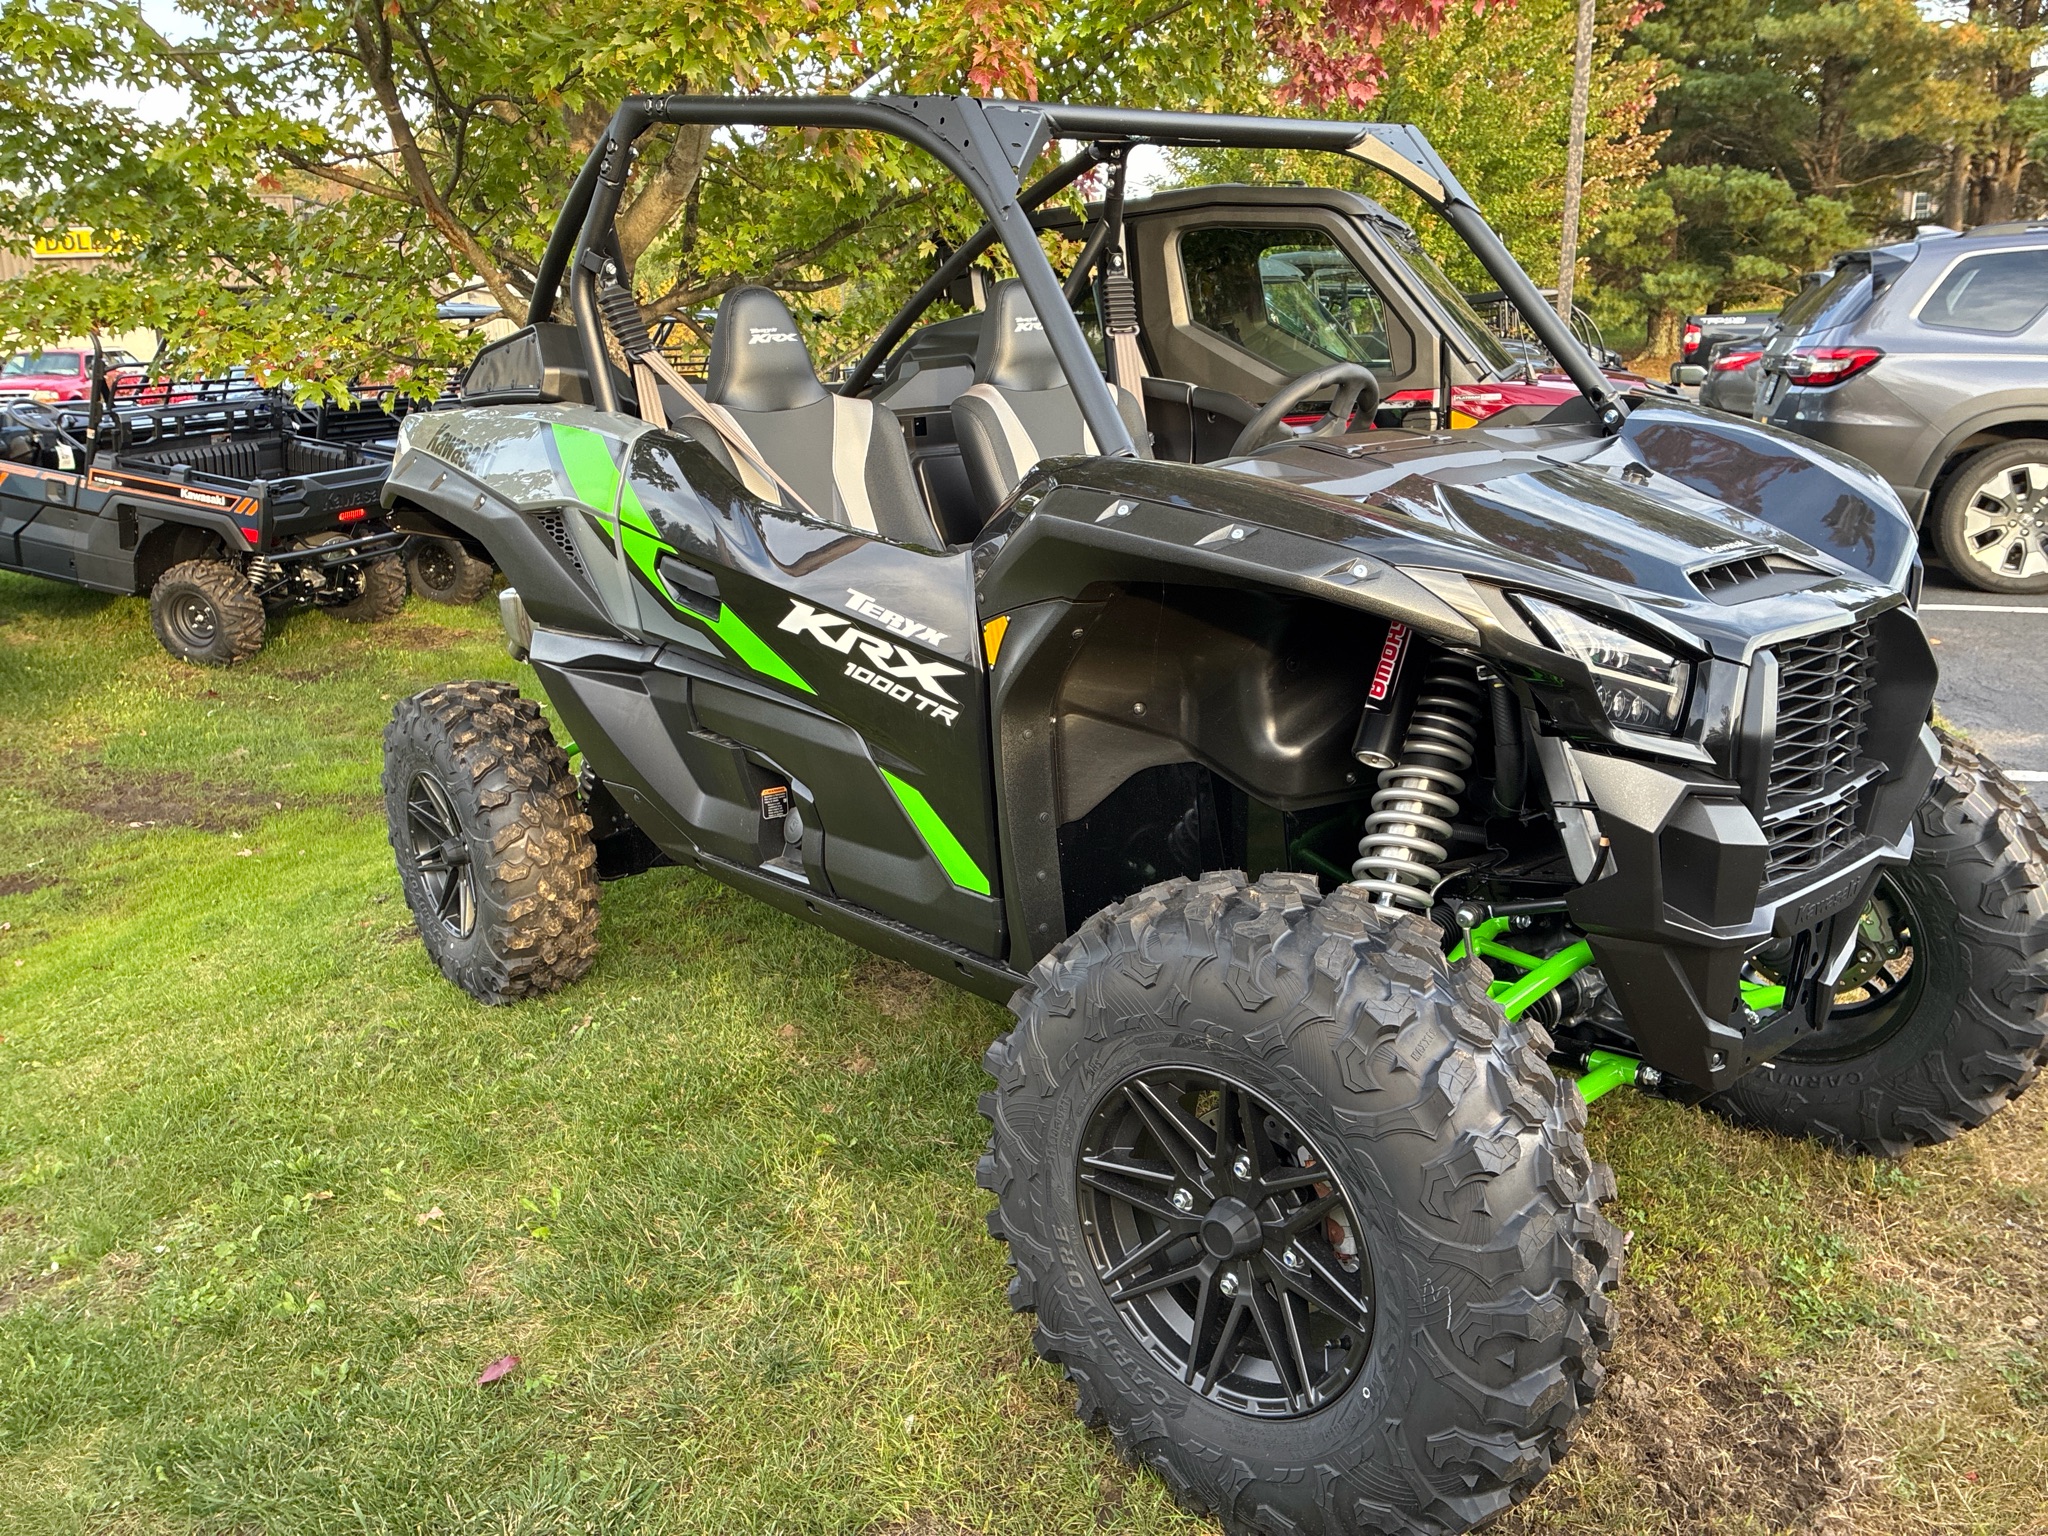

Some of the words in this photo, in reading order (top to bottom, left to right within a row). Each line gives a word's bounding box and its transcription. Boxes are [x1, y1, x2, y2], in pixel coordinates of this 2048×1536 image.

[1014, 322, 1044, 332] KR
[748, 333, 798, 344] KRX
[180, 487, 226, 507] Kawasaki
[323, 489, 381, 511] Kawasa
[777, 598, 967, 704] KRX
[1757, 1069, 1864, 1088] CARNIV
